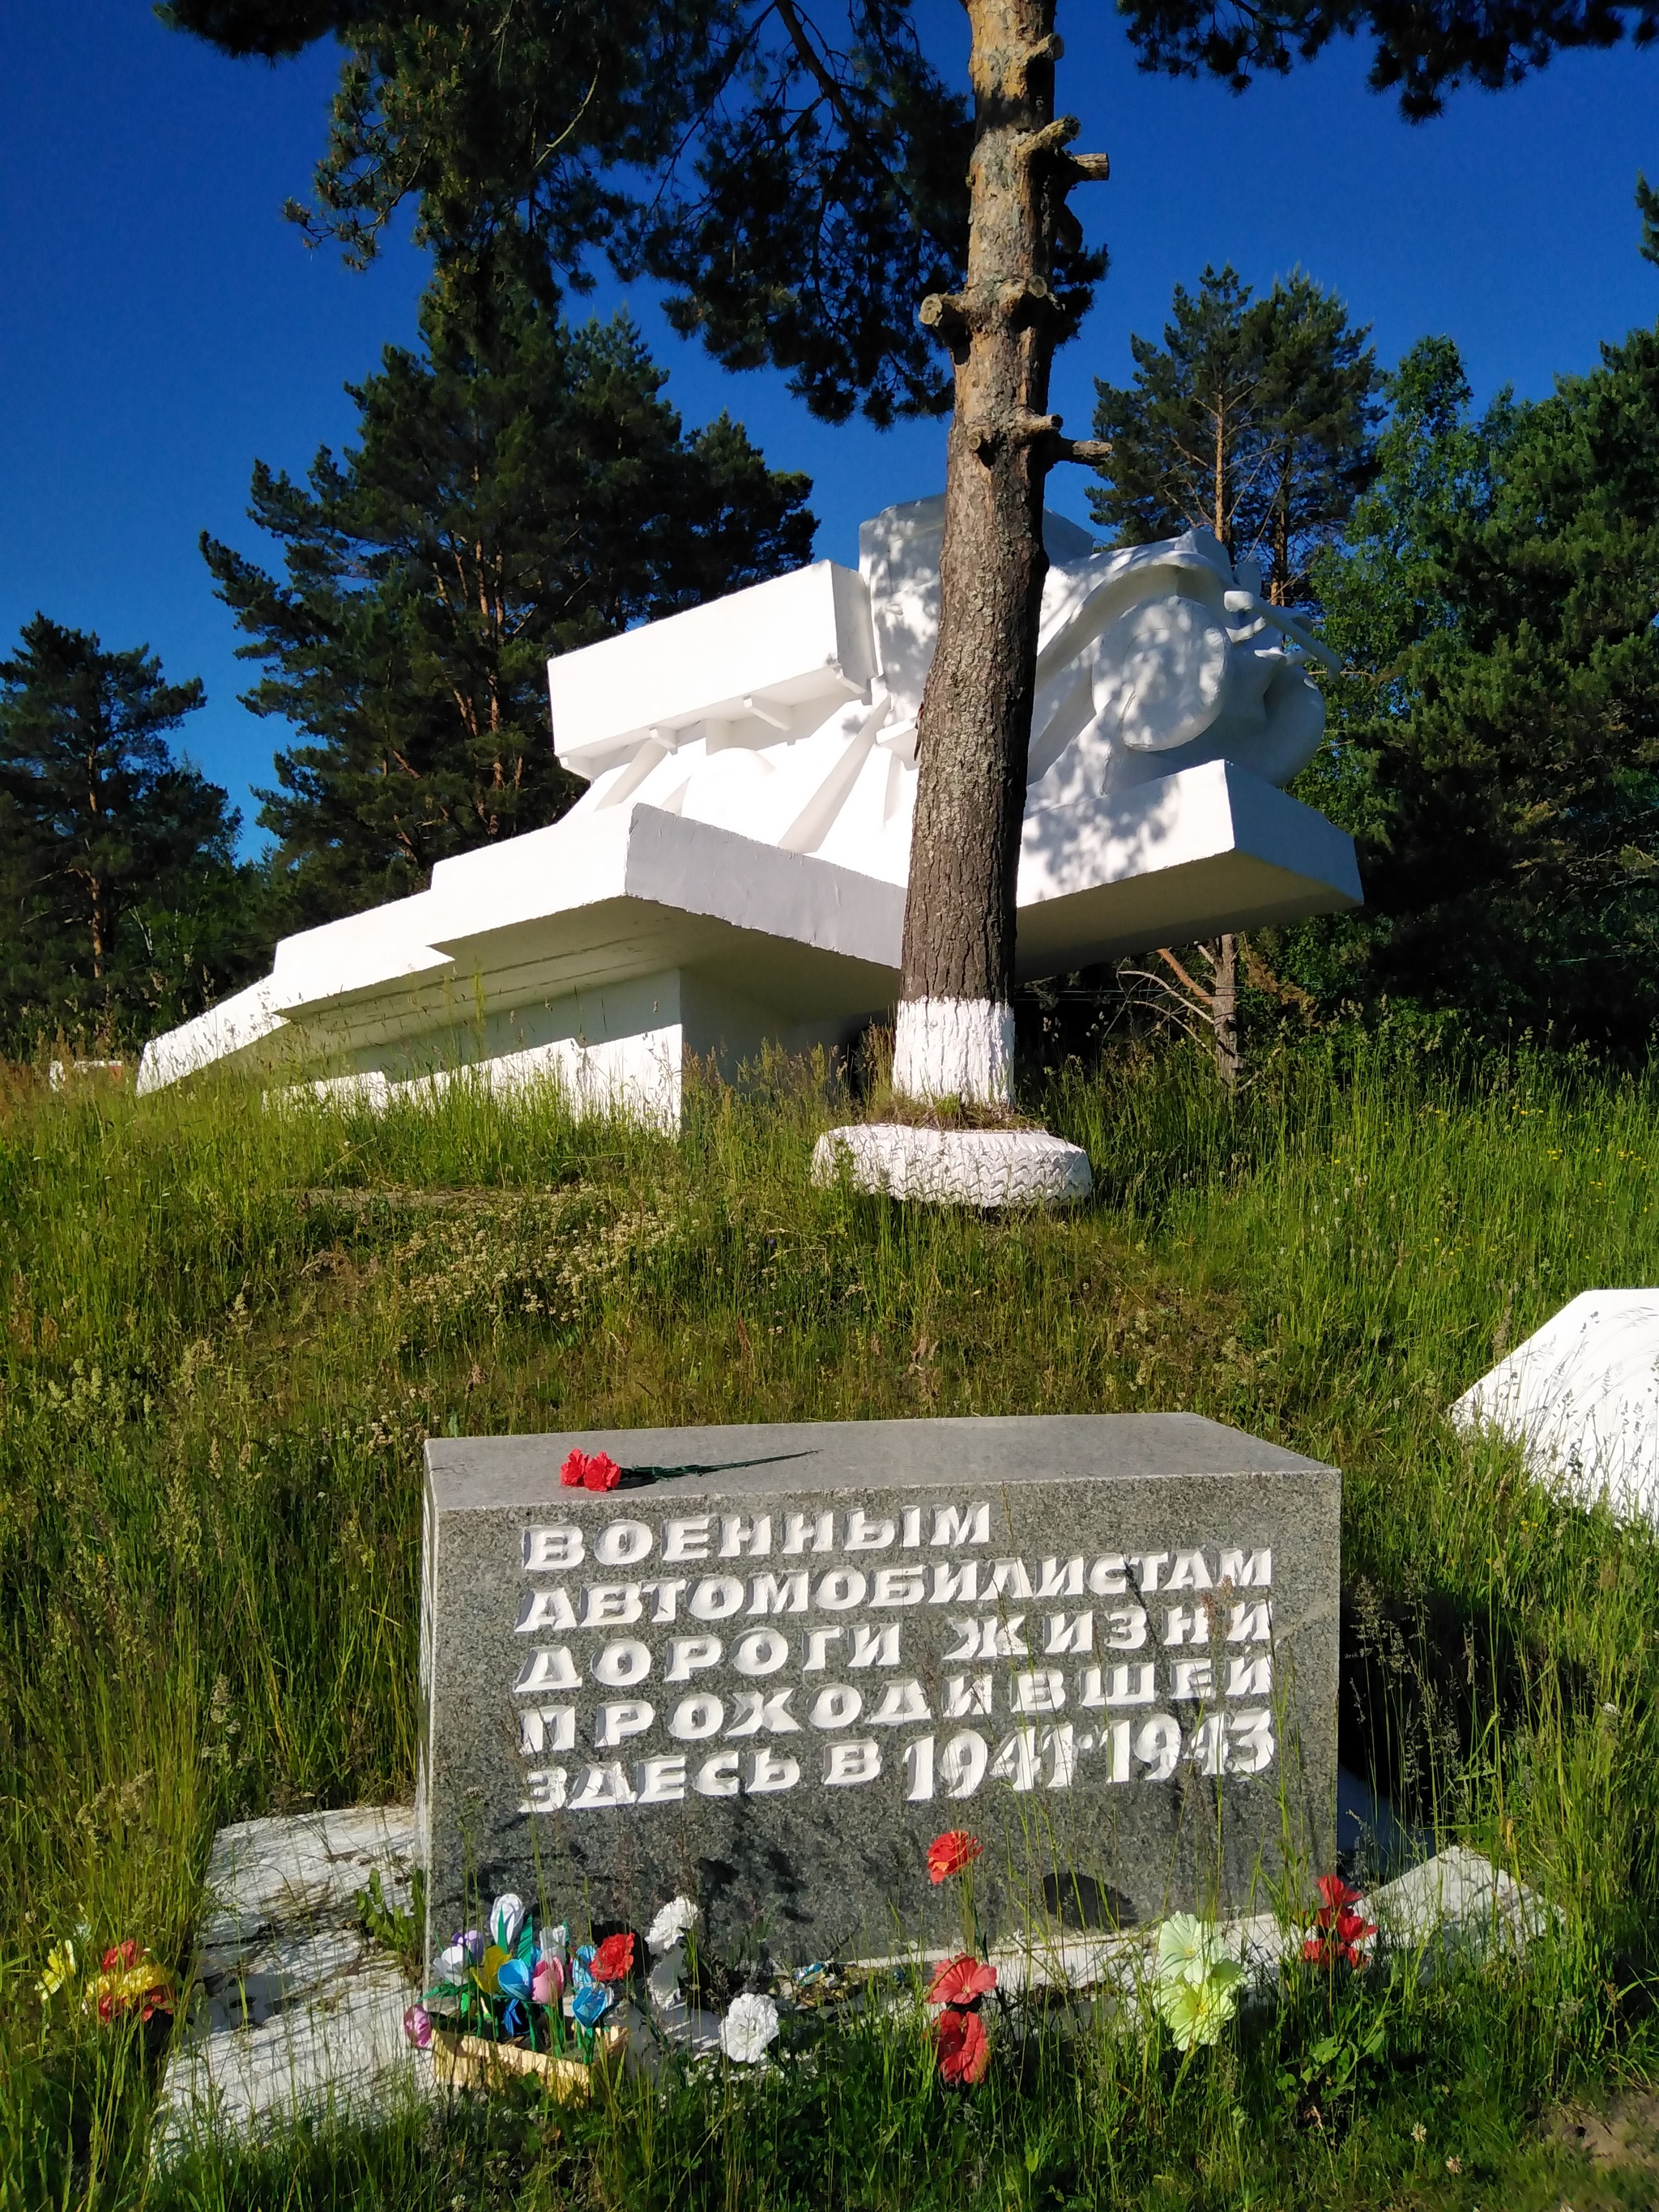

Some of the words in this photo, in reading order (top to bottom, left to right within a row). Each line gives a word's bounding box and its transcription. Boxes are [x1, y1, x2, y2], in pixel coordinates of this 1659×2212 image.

[522, 1501, 990, 1571] ВОЕННЫМ
[514, 1547, 1272, 1633] АВТОМОБИЛИСТАМ
[513, 1622, 901, 1692] ДОРОГИ
[942, 1599, 1272, 1660] ЖИЗНИ
[518, 1645, 1273, 1755] ПРОХОДИВШЕЙ
[516, 1747, 801, 1813] ЗДЕСЬ
[822, 1738, 881, 1785] В
